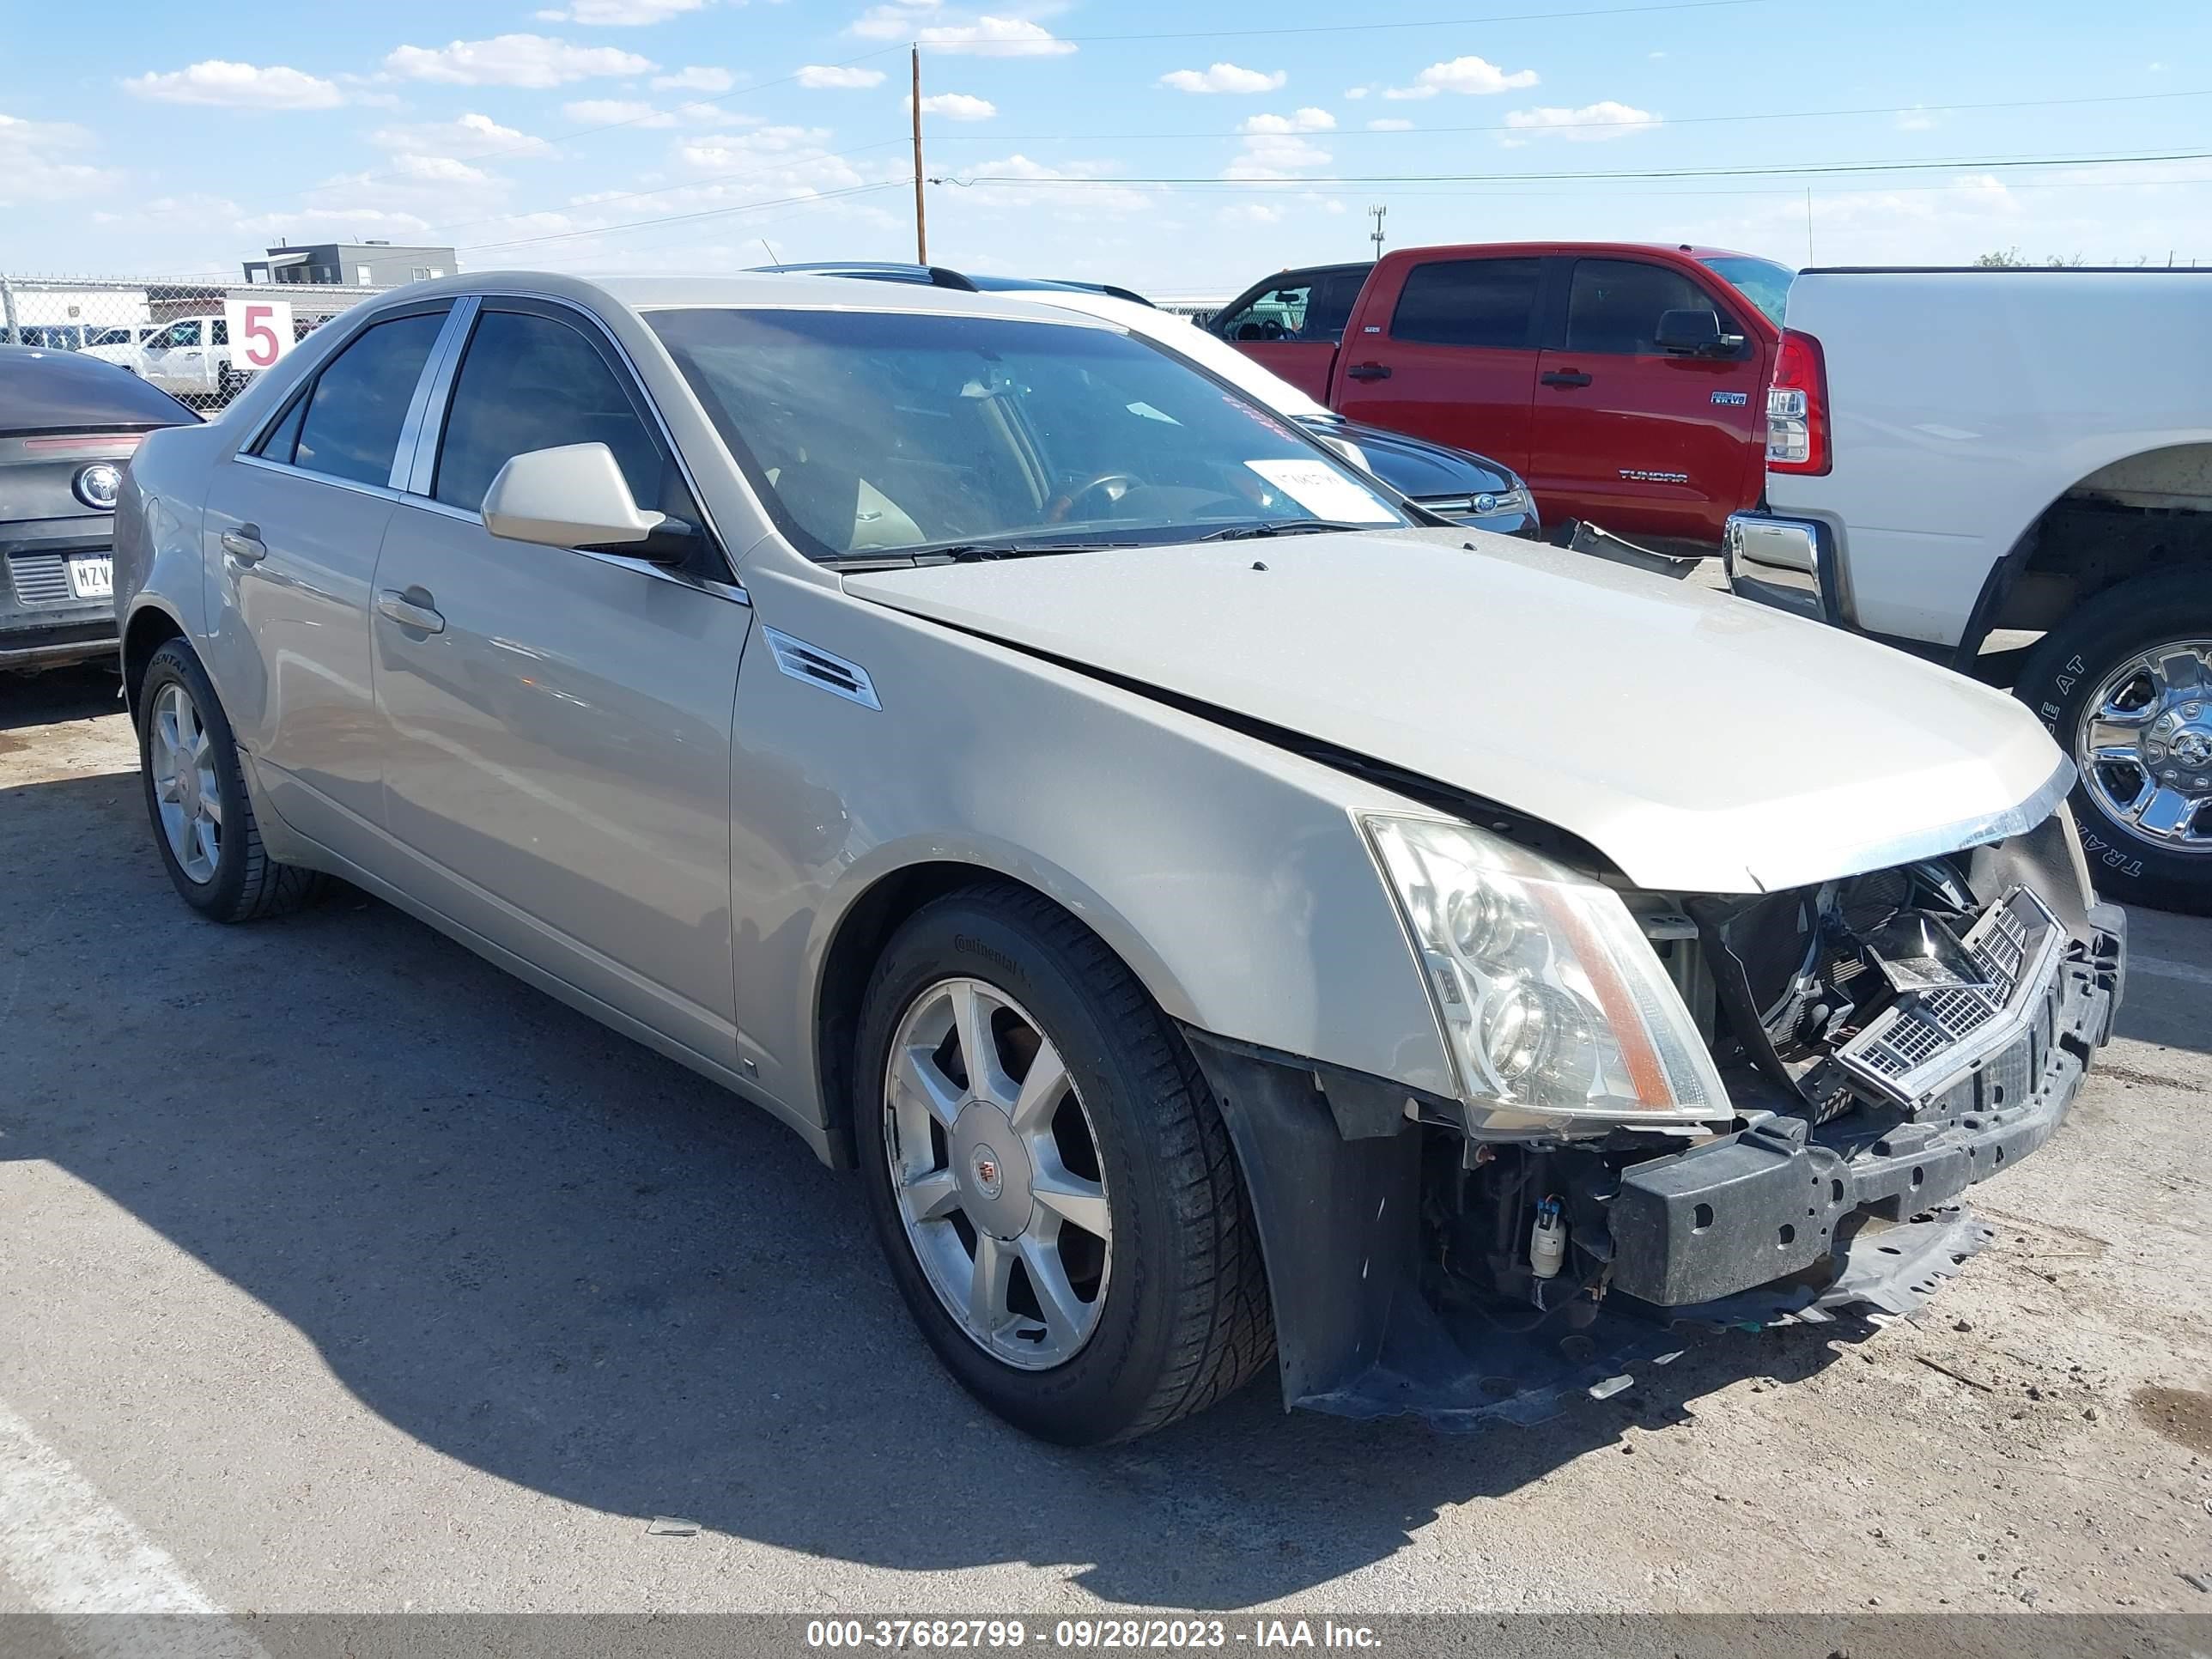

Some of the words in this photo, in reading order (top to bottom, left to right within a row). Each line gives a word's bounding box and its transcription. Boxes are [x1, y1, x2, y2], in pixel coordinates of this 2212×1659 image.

[245, 306, 279, 367] 5
[1619, 470, 1688, 483] TUNDRA
[2056, 654, 2084, 696] AT
[954, 933, 1017, 975] Continental
